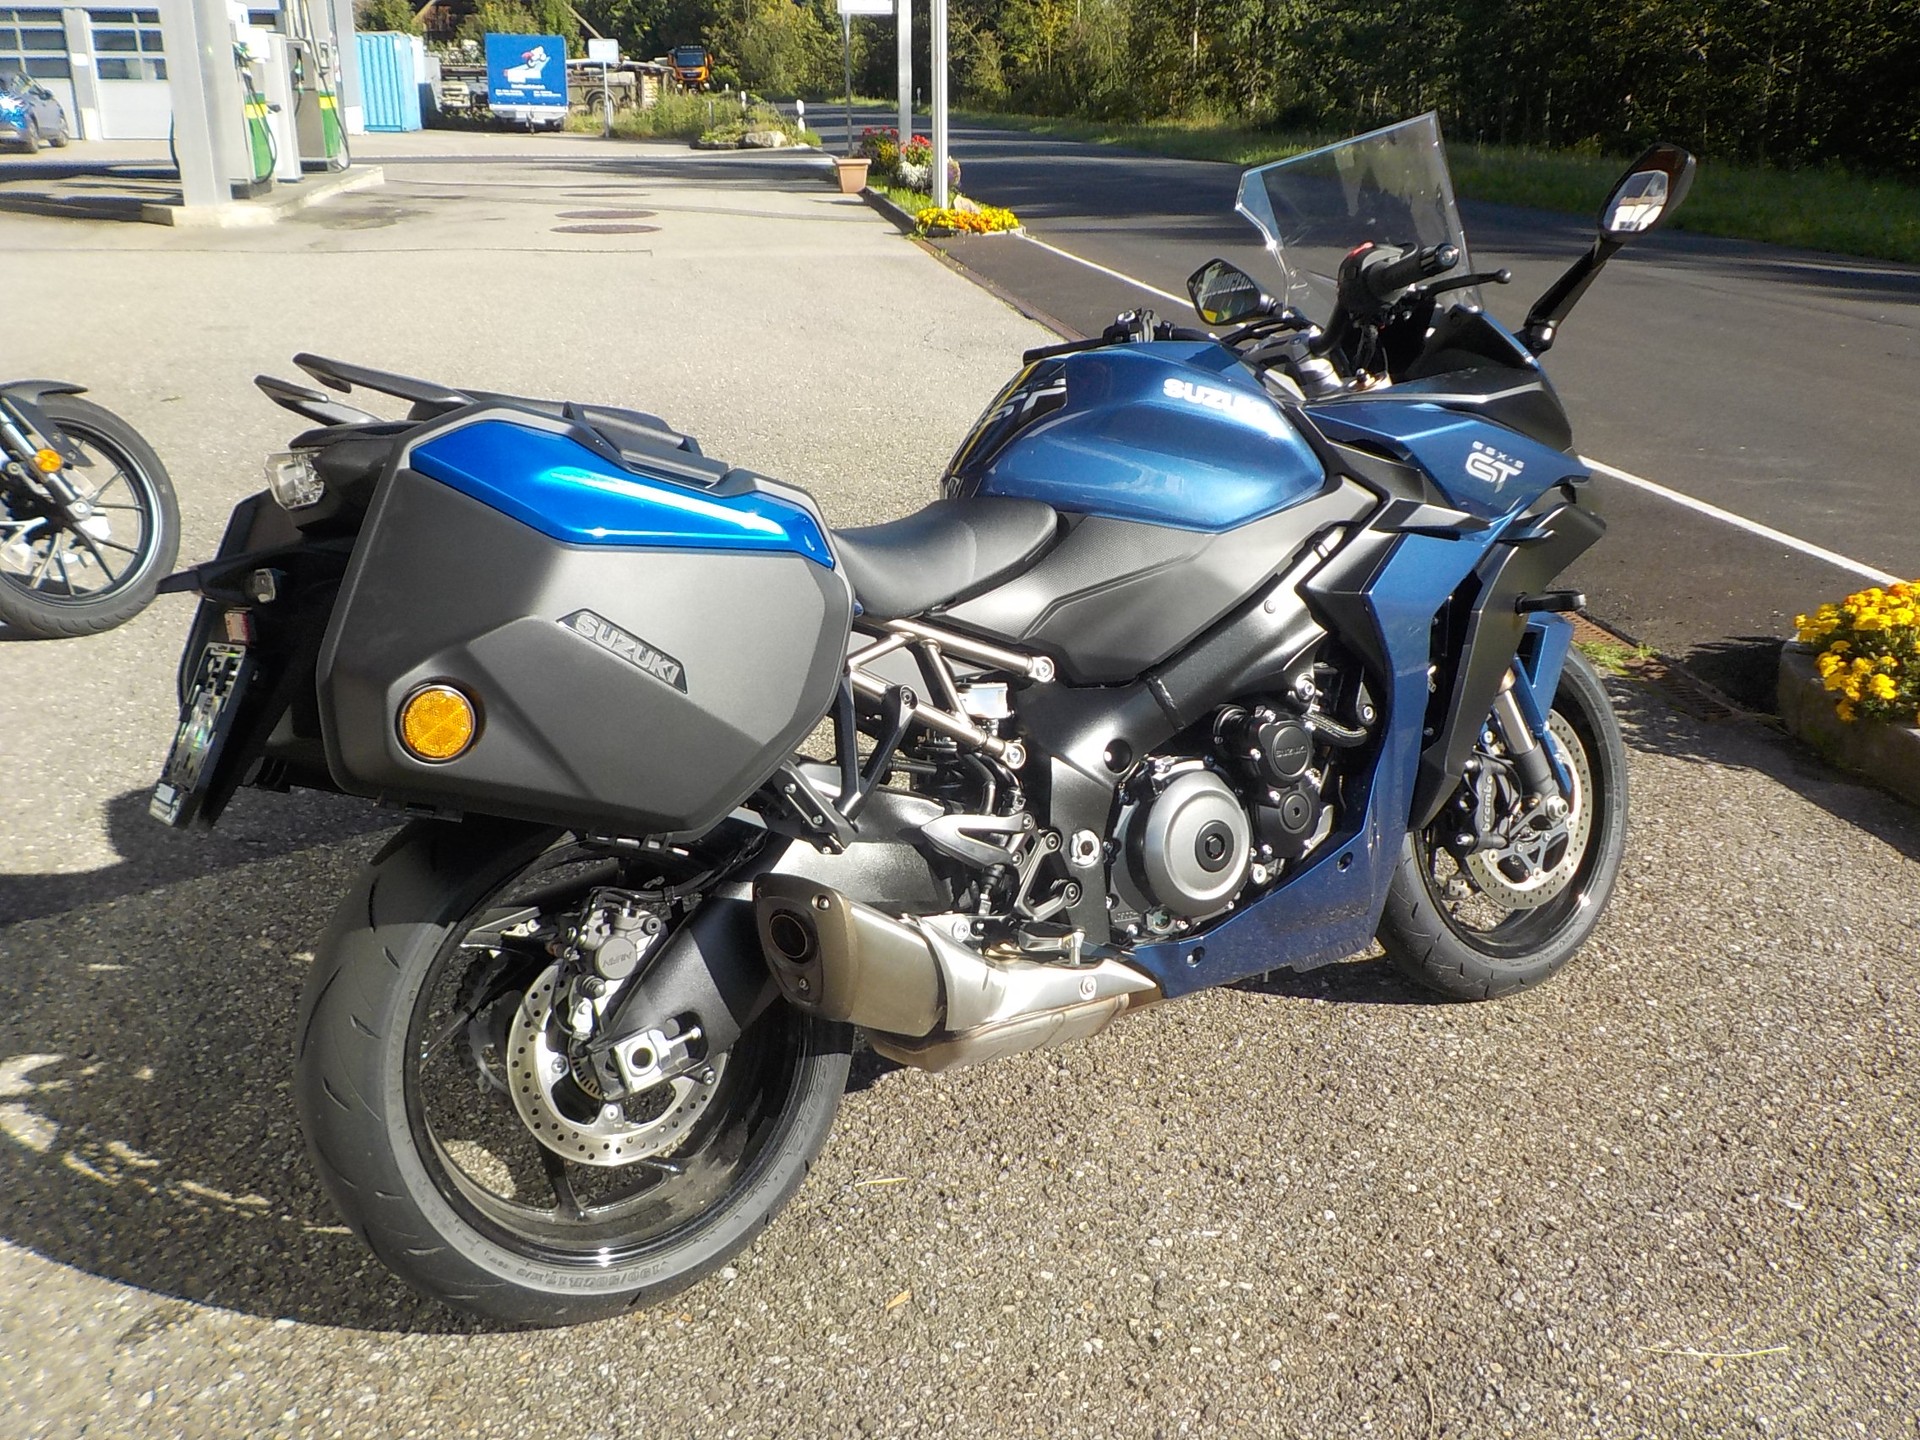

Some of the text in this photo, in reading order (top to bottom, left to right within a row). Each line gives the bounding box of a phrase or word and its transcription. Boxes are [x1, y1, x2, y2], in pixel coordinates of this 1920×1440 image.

[1163, 378, 1268, 424] SUZU
[1465, 452, 1522, 494] GT
[575, 613, 681, 685] SUZUKI
[1482, 774, 1493, 832] brembo
